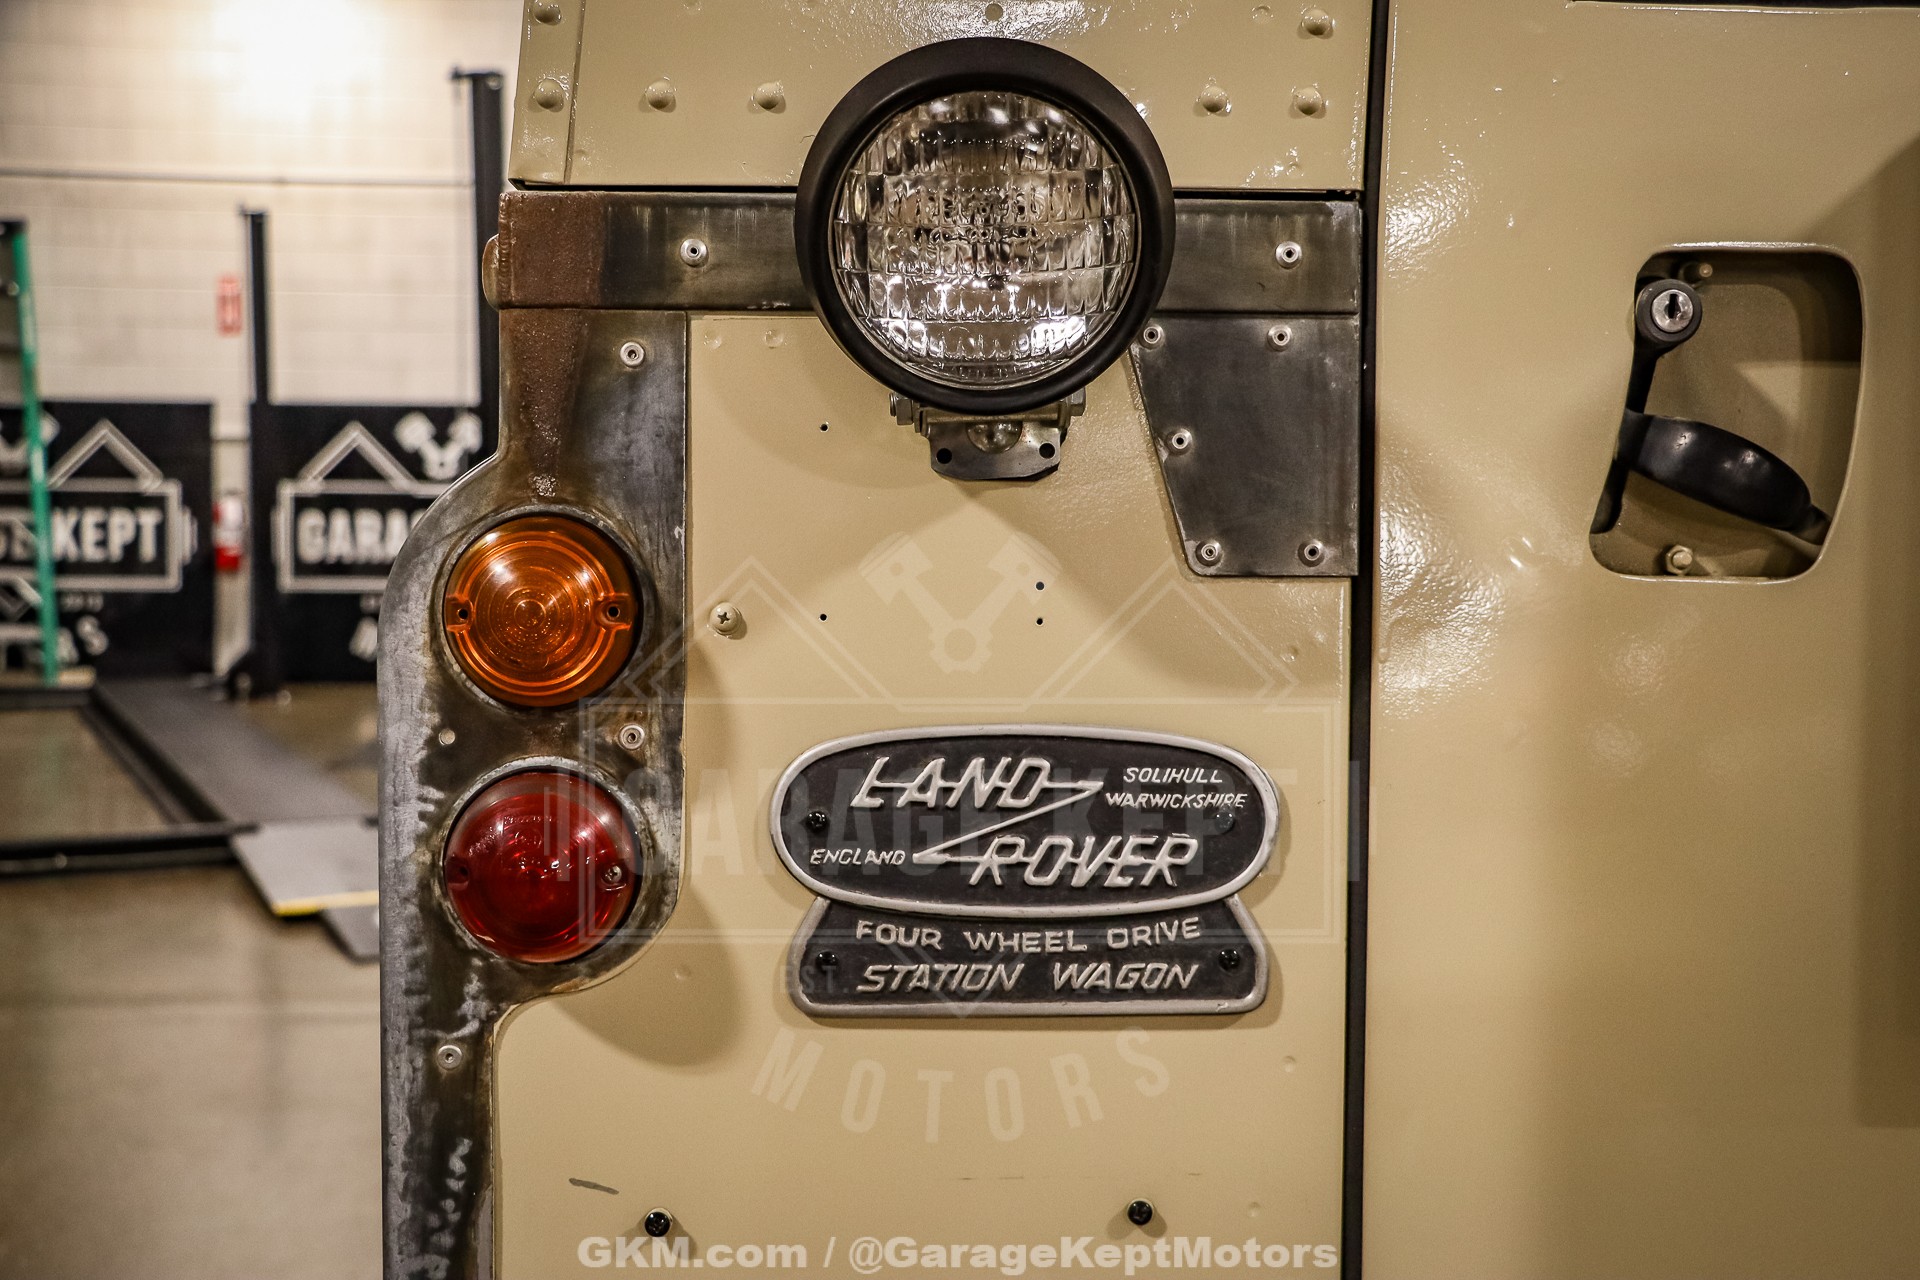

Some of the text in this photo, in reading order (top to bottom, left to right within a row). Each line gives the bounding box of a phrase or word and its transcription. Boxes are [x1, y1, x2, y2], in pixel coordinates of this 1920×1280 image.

[53, 507, 164, 563] KEPT
[850, 756, 1052, 808] LAND
[1123, 766, 1223, 784] SOLIHULL
[1105, 791, 1248, 809] WARWICKSHIRE
[810, 847, 906, 866] ENGLAND
[968, 834, 1199, 888] ROVER
[855, 916, 1201, 954] FOUR WHEEL DRIVE
[855, 962, 1024, 993] STATION
[1052, 962, 1200, 993] WAGON
